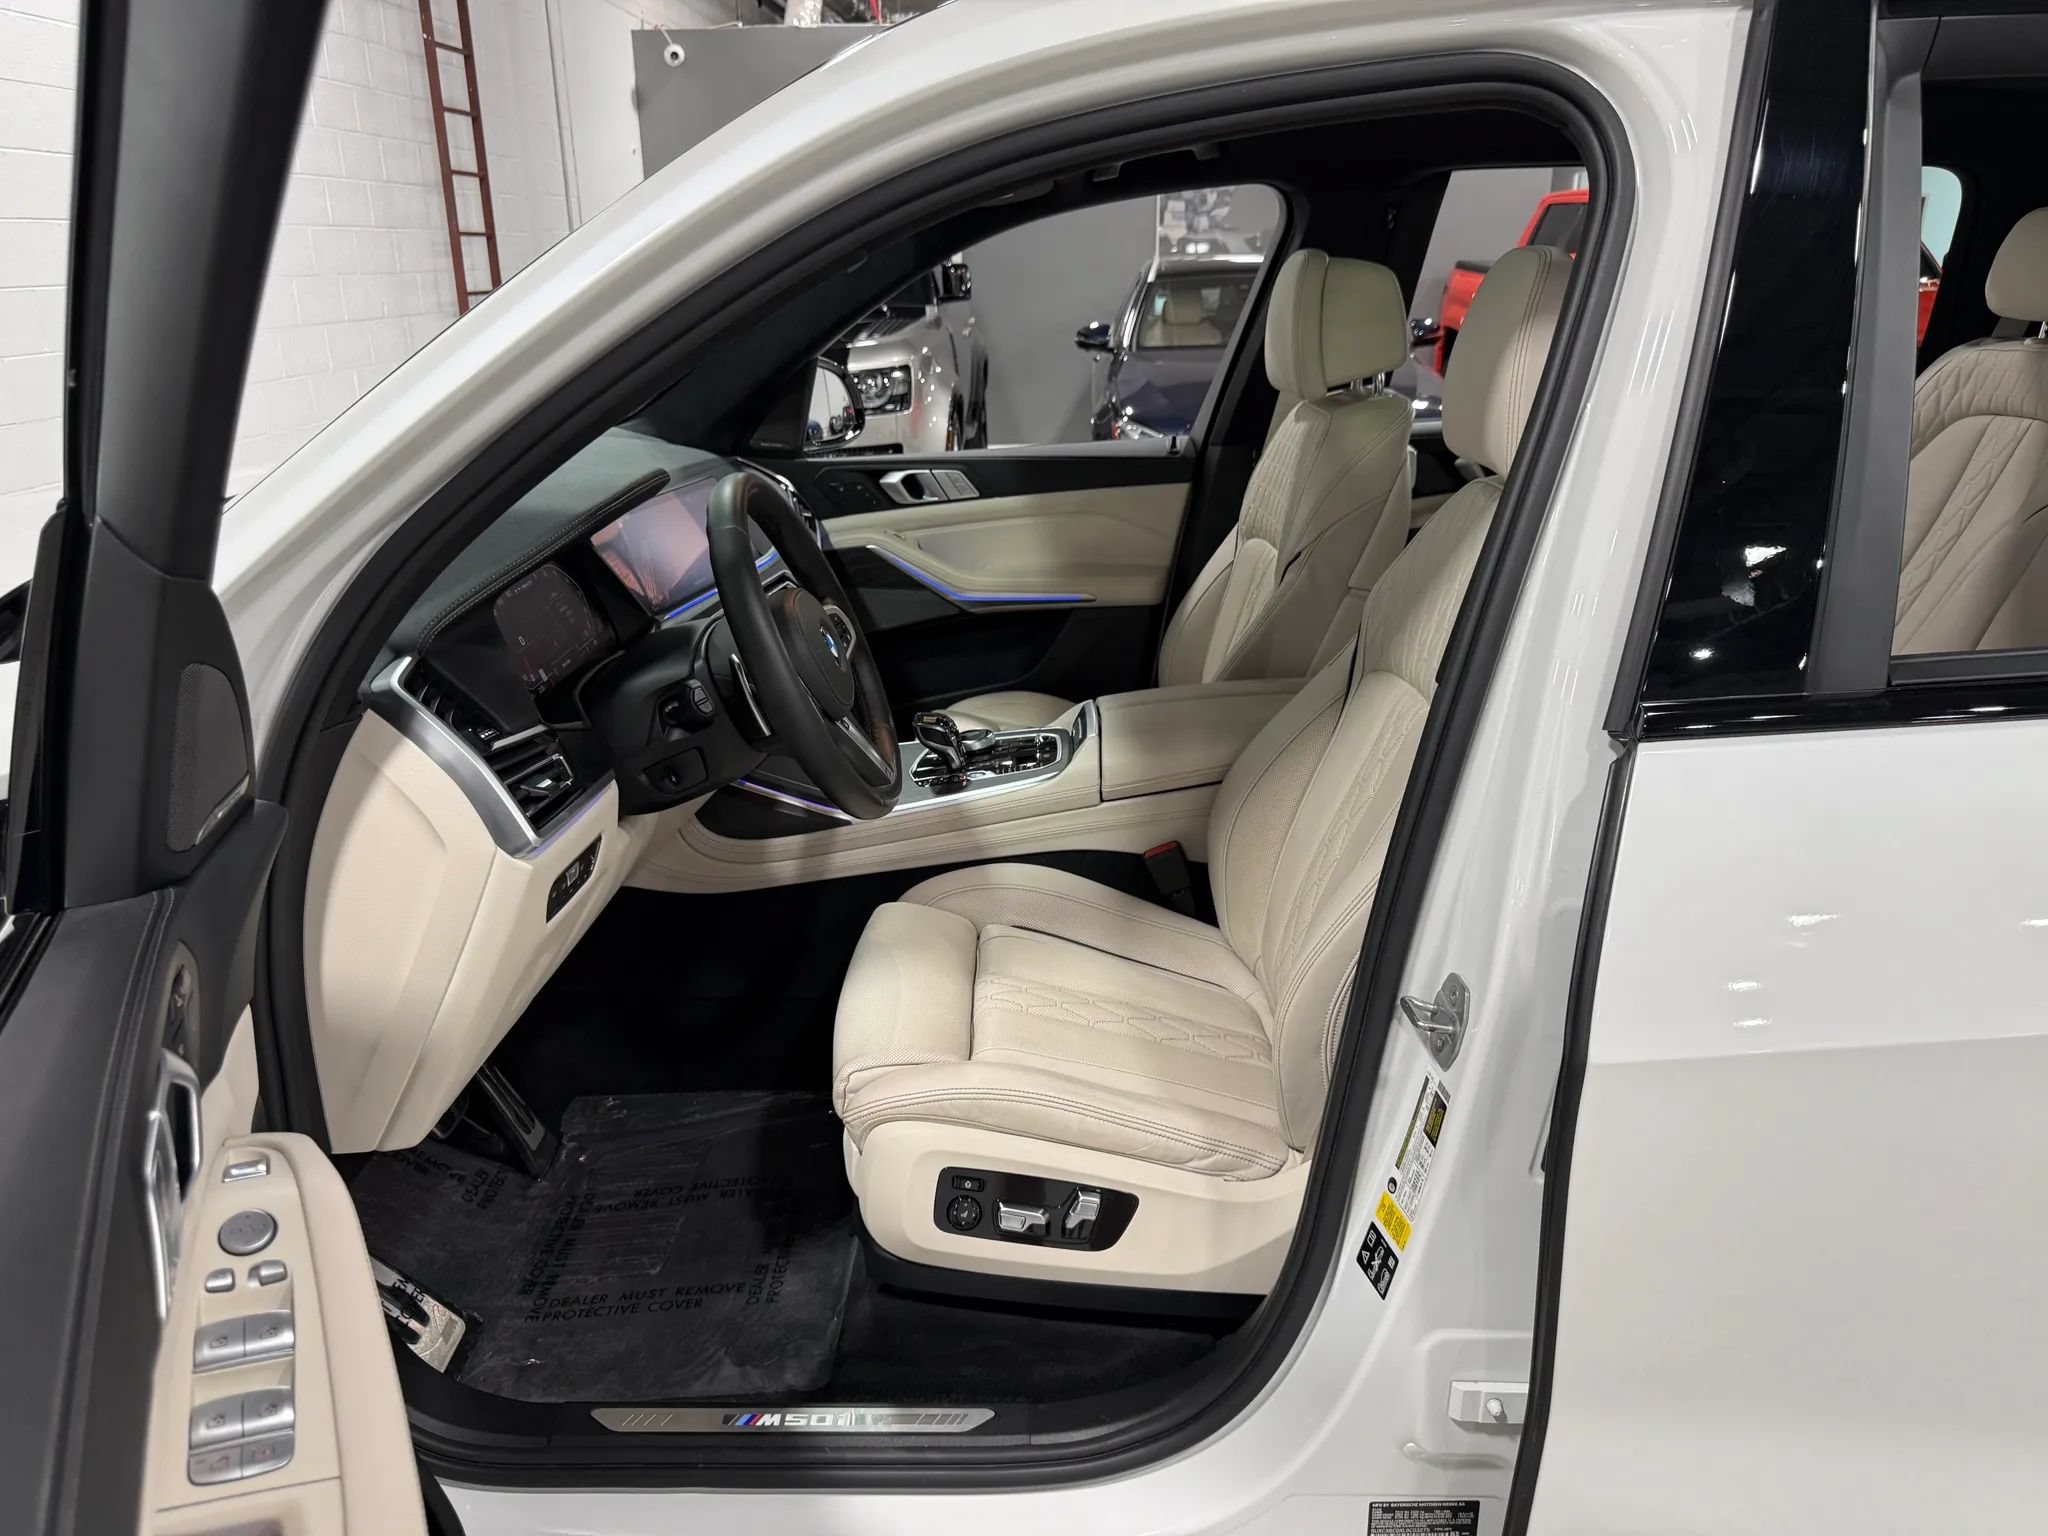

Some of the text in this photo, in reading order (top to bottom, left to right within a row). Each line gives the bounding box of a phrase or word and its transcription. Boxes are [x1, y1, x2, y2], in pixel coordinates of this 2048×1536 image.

[548, 1282, 746, 1309] DEALER MUST REMOVE
[541, 1298, 704, 1323] PROTECTIVE COVER
